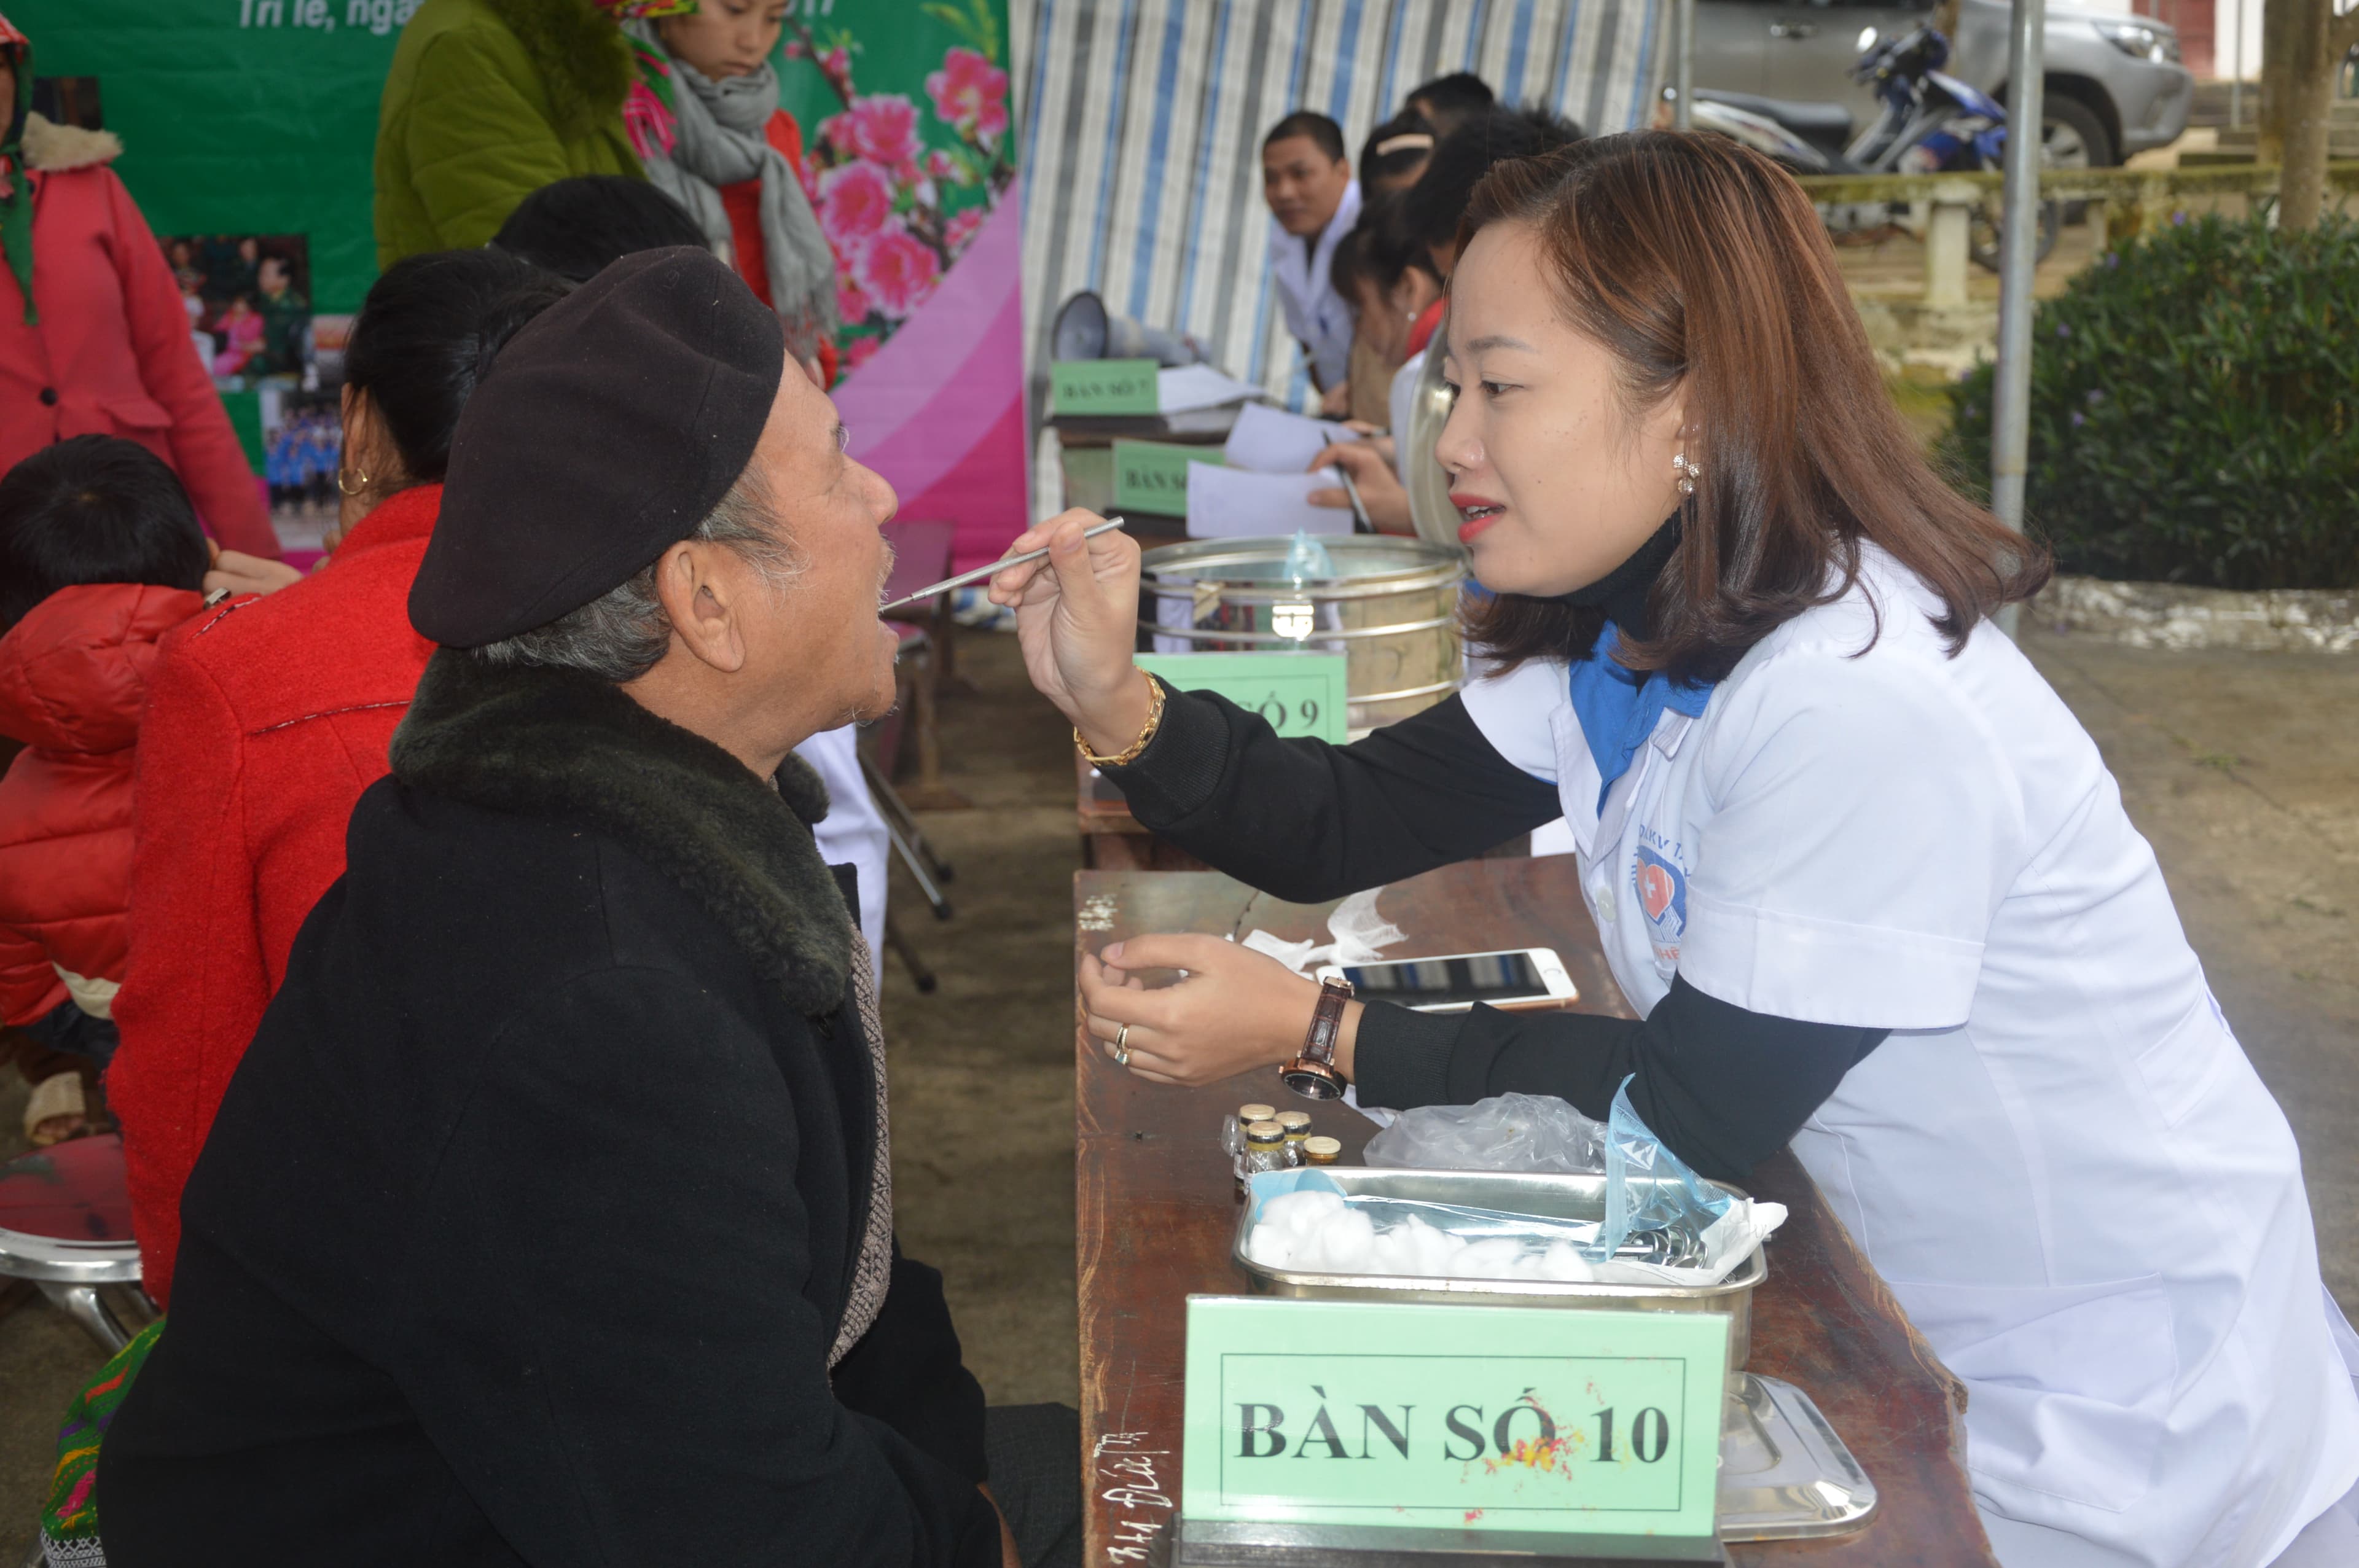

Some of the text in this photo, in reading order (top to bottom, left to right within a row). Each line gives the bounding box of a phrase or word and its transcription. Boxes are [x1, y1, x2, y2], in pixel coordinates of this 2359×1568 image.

[1170, 472, 1187, 491] S
[1235, 689, 1319, 731] Ố 9
[1233, 1384, 1670, 1464] BÀN SỐ 10
